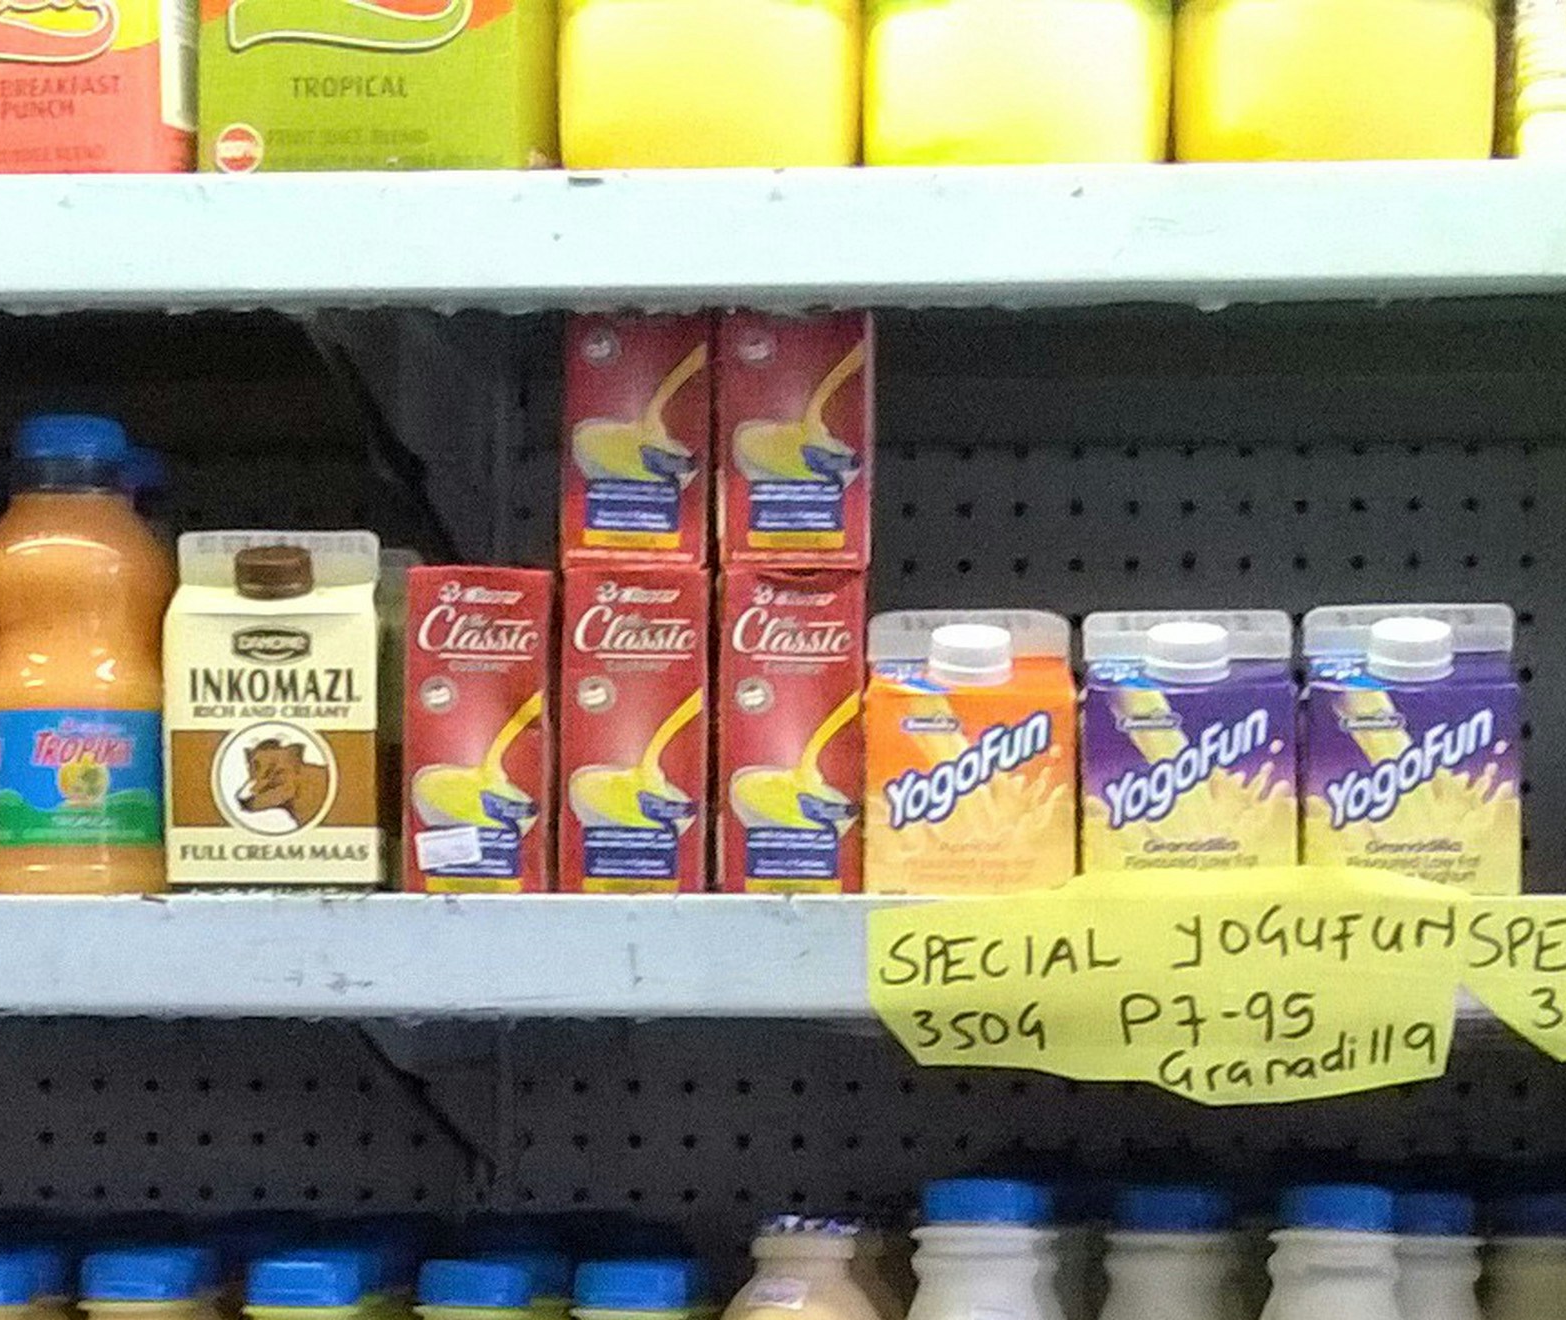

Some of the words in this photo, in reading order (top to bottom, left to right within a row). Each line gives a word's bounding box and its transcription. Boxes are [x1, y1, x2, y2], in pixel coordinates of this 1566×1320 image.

[290, 76, 409, 99] TROPICAL
[417, 604, 539, 652] Classic
[574, 604, 696, 653] Classic
[733, 604, 853, 654] Classic
[191, 668, 355, 703] INKOMAZI
[887, 710, 1051, 830] YogoFun
[1105, 707, 1269, 829] YogoFun
[1326, 707, 1494, 829] YogoFun
[180, 844, 228, 861] FULL
[231, 844, 305, 861] CREAM
[879, 928, 1121, 985] SPECIAL
